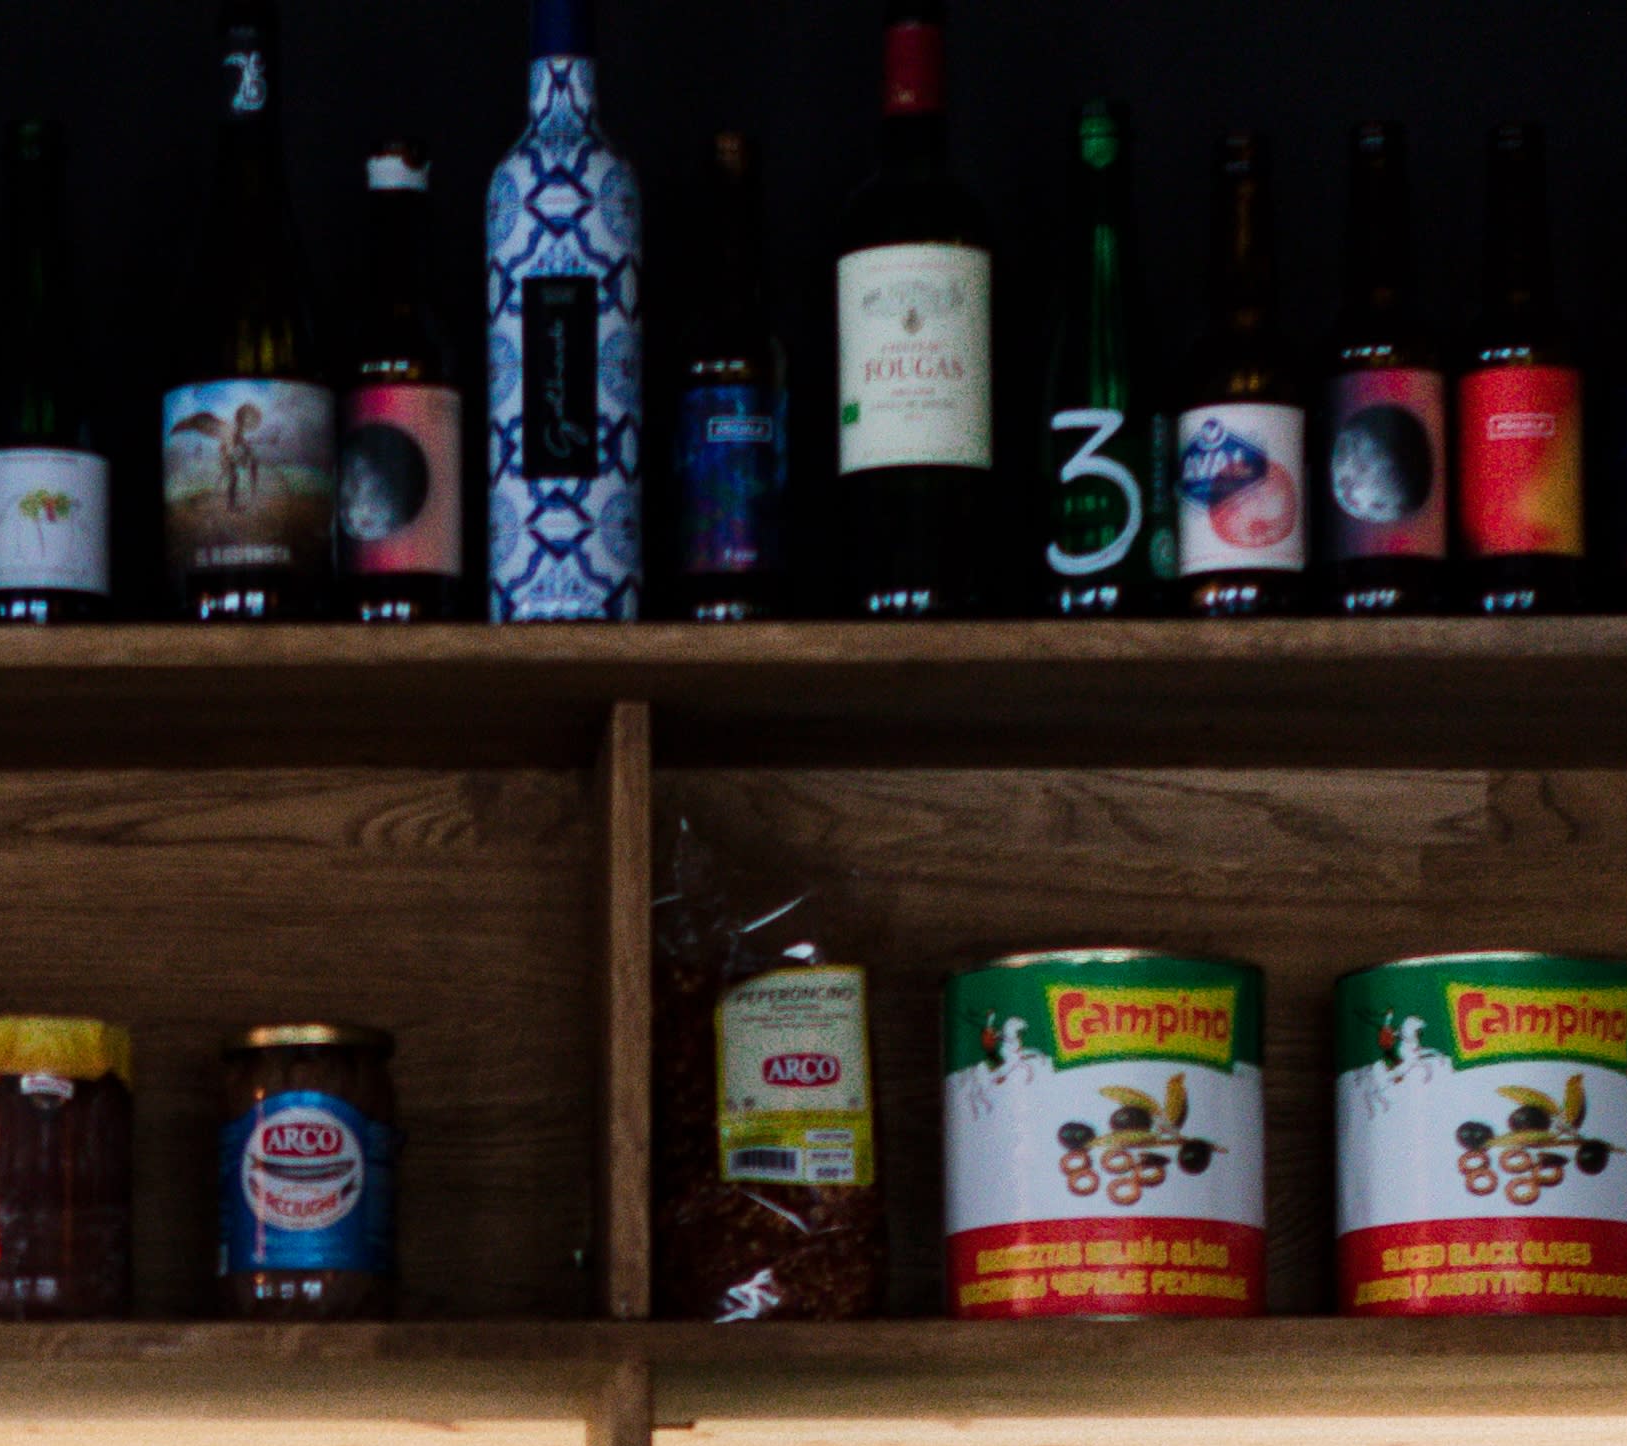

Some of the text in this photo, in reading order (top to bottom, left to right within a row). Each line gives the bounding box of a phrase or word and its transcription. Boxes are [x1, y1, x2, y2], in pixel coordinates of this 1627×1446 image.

[1044, 406, 1144, 577] 3
[1058, 990, 1230, 1050] Campino
[767, 1057, 837, 1083] ARCO
[263, 1126, 339, 1154] ARCO
